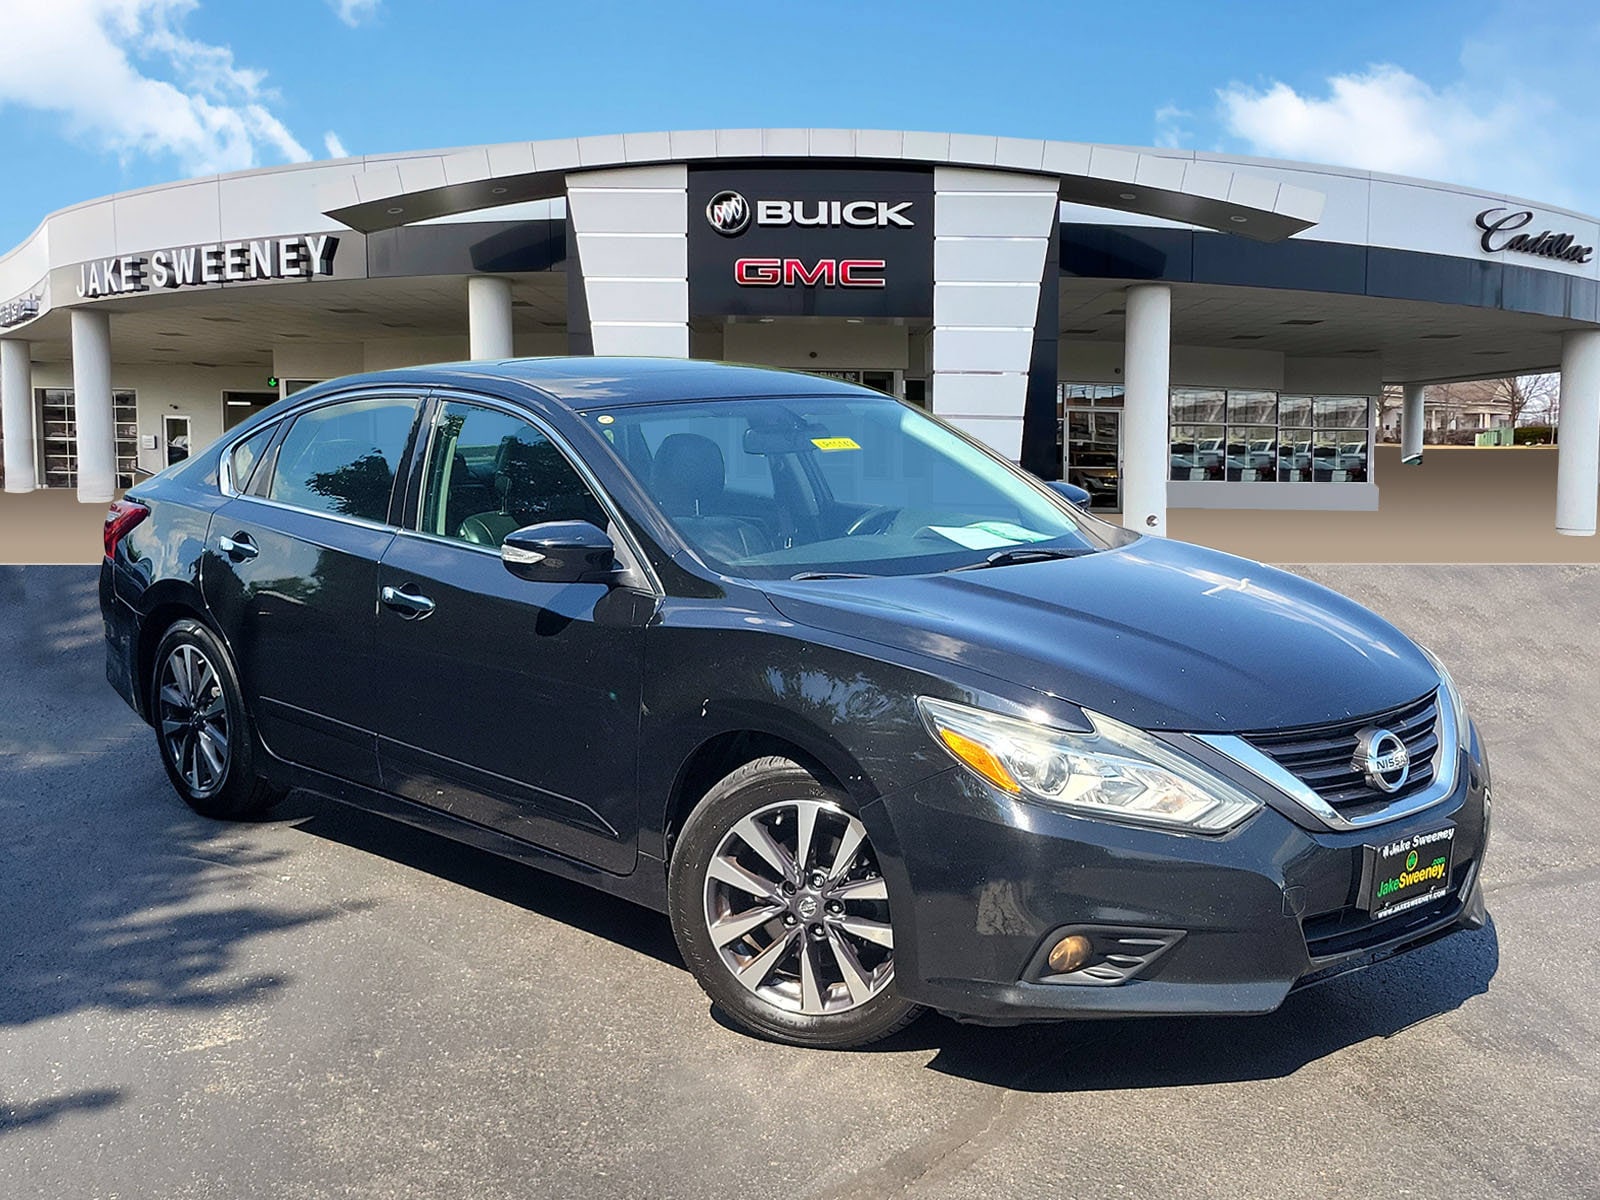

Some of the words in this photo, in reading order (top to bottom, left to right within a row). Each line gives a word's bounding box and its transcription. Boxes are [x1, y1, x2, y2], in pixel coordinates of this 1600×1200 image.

[757, 200, 916, 227] BUICK
[1475, 207, 1594, 264] Cadillac
[76, 255, 136, 298] JAKE
[151, 234, 330, 288] SWEENEY
[734, 258, 887, 287] GMC
